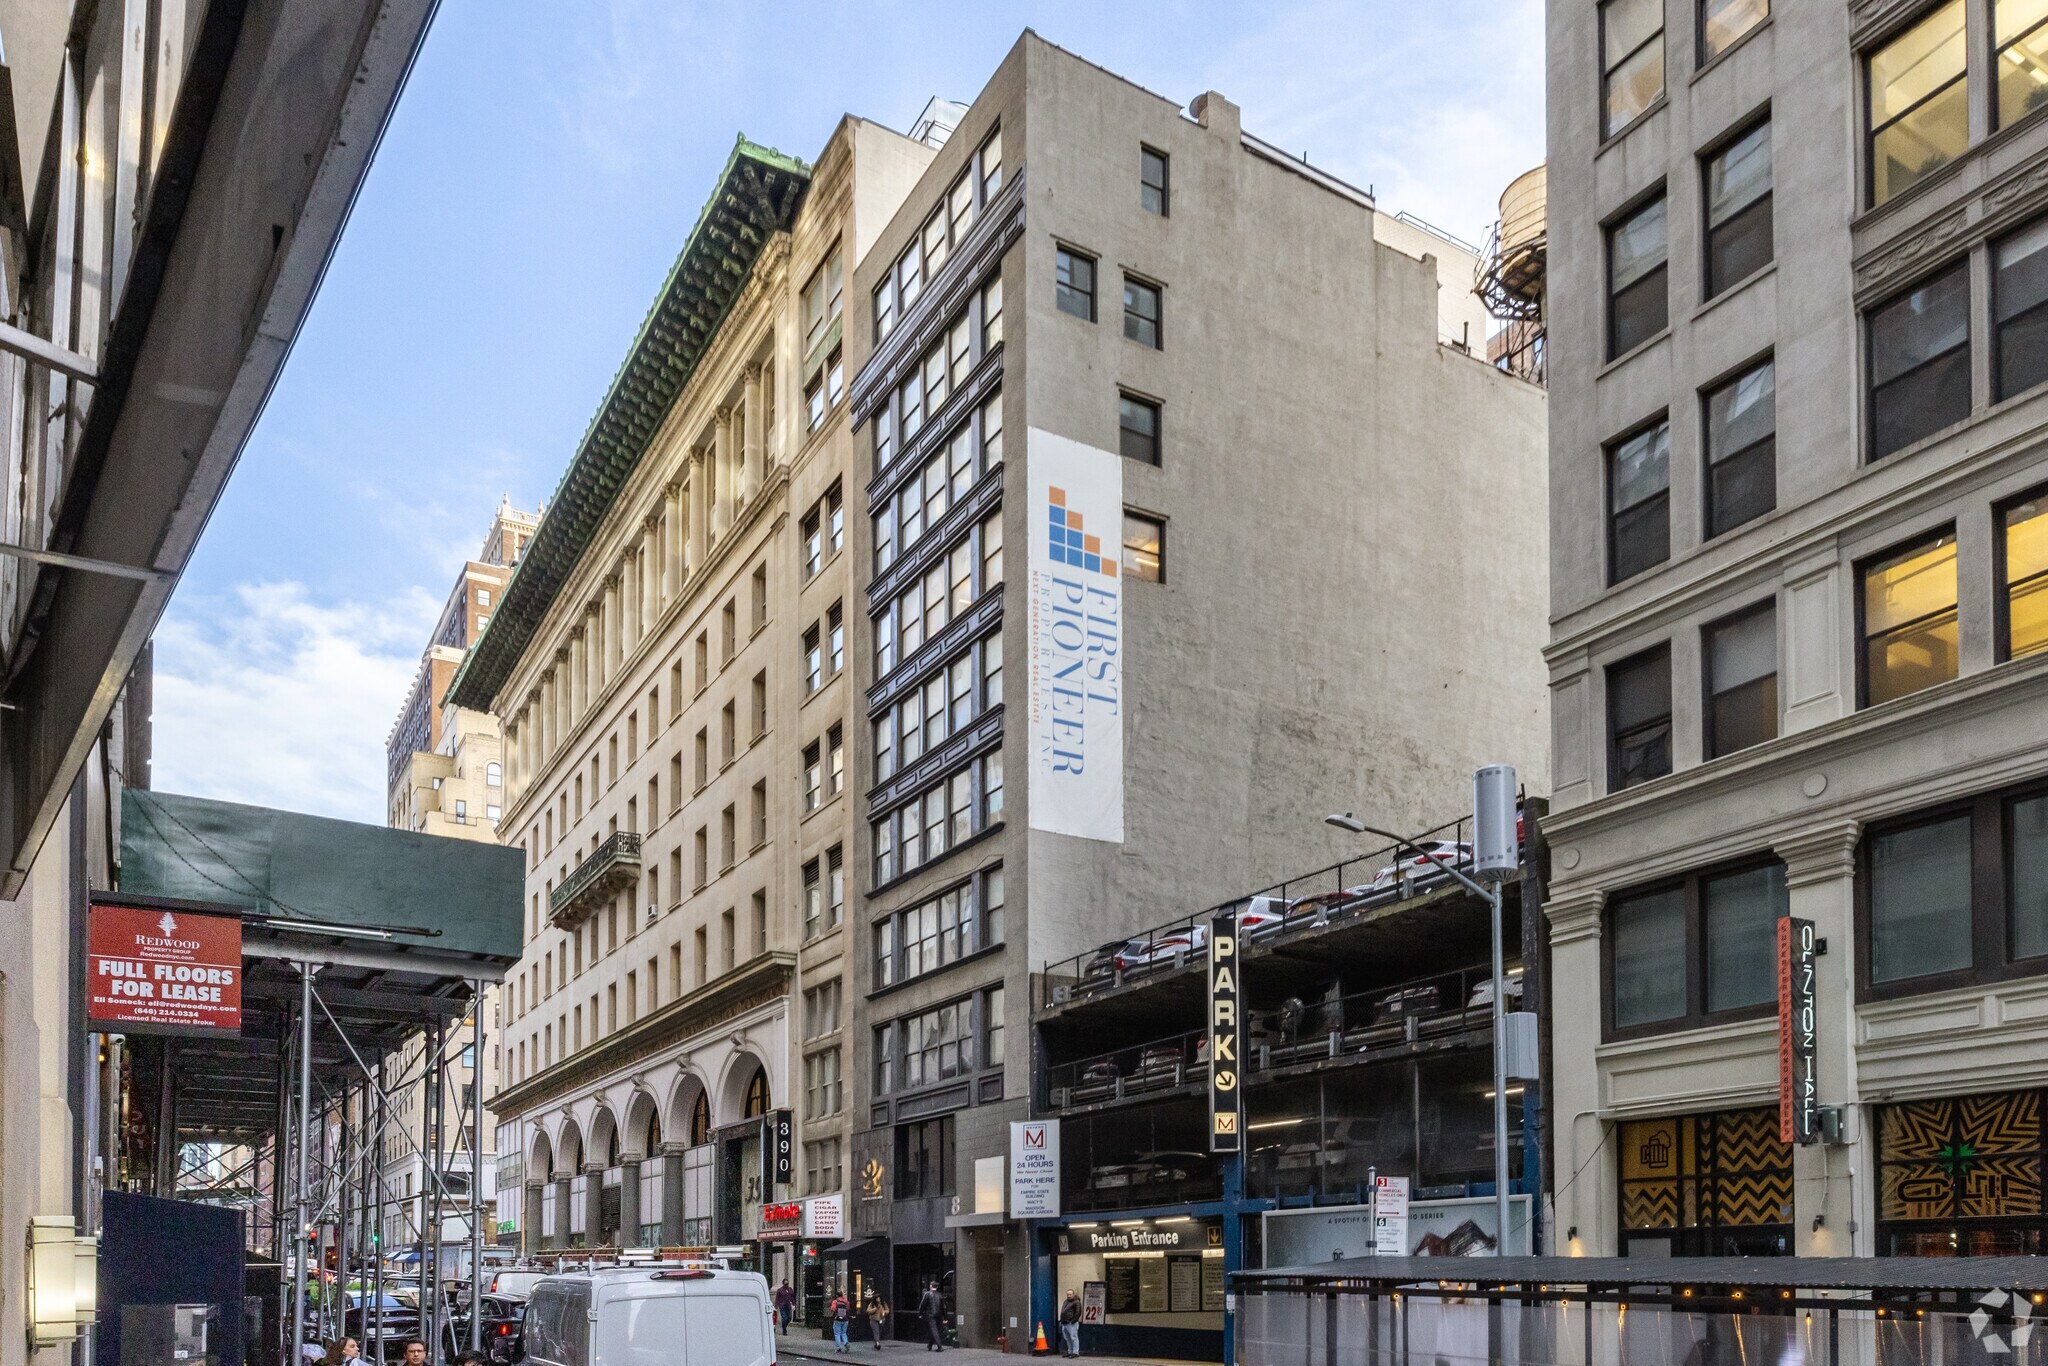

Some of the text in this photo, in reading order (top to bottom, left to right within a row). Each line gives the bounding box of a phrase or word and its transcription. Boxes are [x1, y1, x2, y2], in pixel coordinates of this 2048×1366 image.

[1086, 583, 1118, 715] FIRST
[1052, 572, 1084, 775] PIONEER
[135, 935, 200, 950] REDWOOD
[140, 952, 194, 960] Redwoodnyc.com
[98, 960, 234, 985] FULL FLOORS
[112, 980, 222, 1002] FOR LEASE
[1214, 936, 1236, 1060] PARK
[108, 998, 146, 1006] Someck:
[148, 1000, 237, 1012] eli@redwoodnyc.com
[158, 1009, 199, 1018] 214.0334
[1802, 926, 1814, 1134] CLINTON HALL
[780, 1122, 789, 1172] 390
[952, 1196, 960, 1215] 8
[1091, 1231, 1179, 1249] Parking Entrance
[1085, 1306, 1096, 1320] 22
